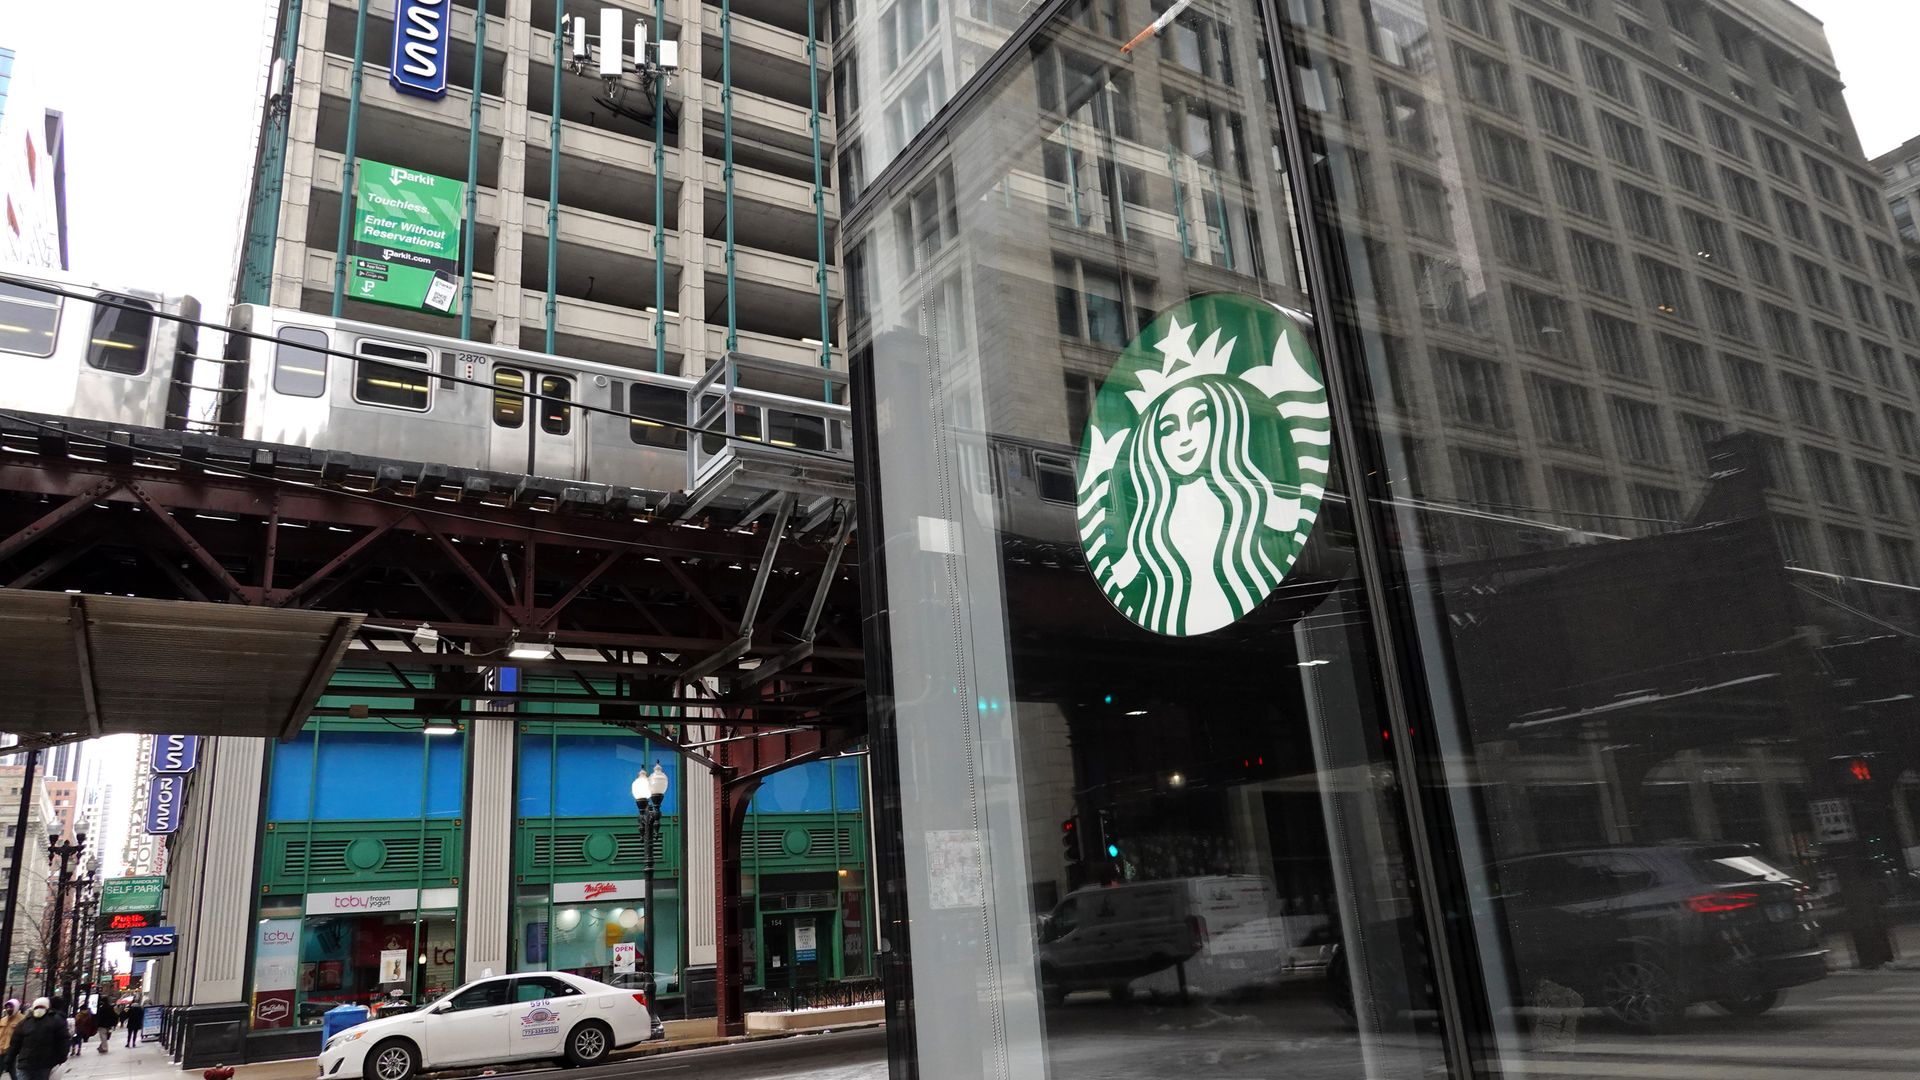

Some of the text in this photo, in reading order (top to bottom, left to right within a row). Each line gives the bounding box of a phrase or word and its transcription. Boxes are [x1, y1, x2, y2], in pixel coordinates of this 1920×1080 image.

[403, 0, 443, 77] SS
[389, 168, 435, 187] iParkit
[367, 192, 430, 215] Touchless.
[364, 214, 446, 240] Enter Without
[363, 225, 444, 250] Reservations.
[382, 248, 431, 265] iParkit.com
[459, 353, 486, 365] 2870
[156, 778, 174, 830] ROSS
[106, 884, 161, 894] SELF PARK
[369, 900, 391, 908] yogurt
[131, 934, 173, 946] ROSS
[615, 945, 634, 953] OPEN
[530, 1000, 550, 1008] 5916
